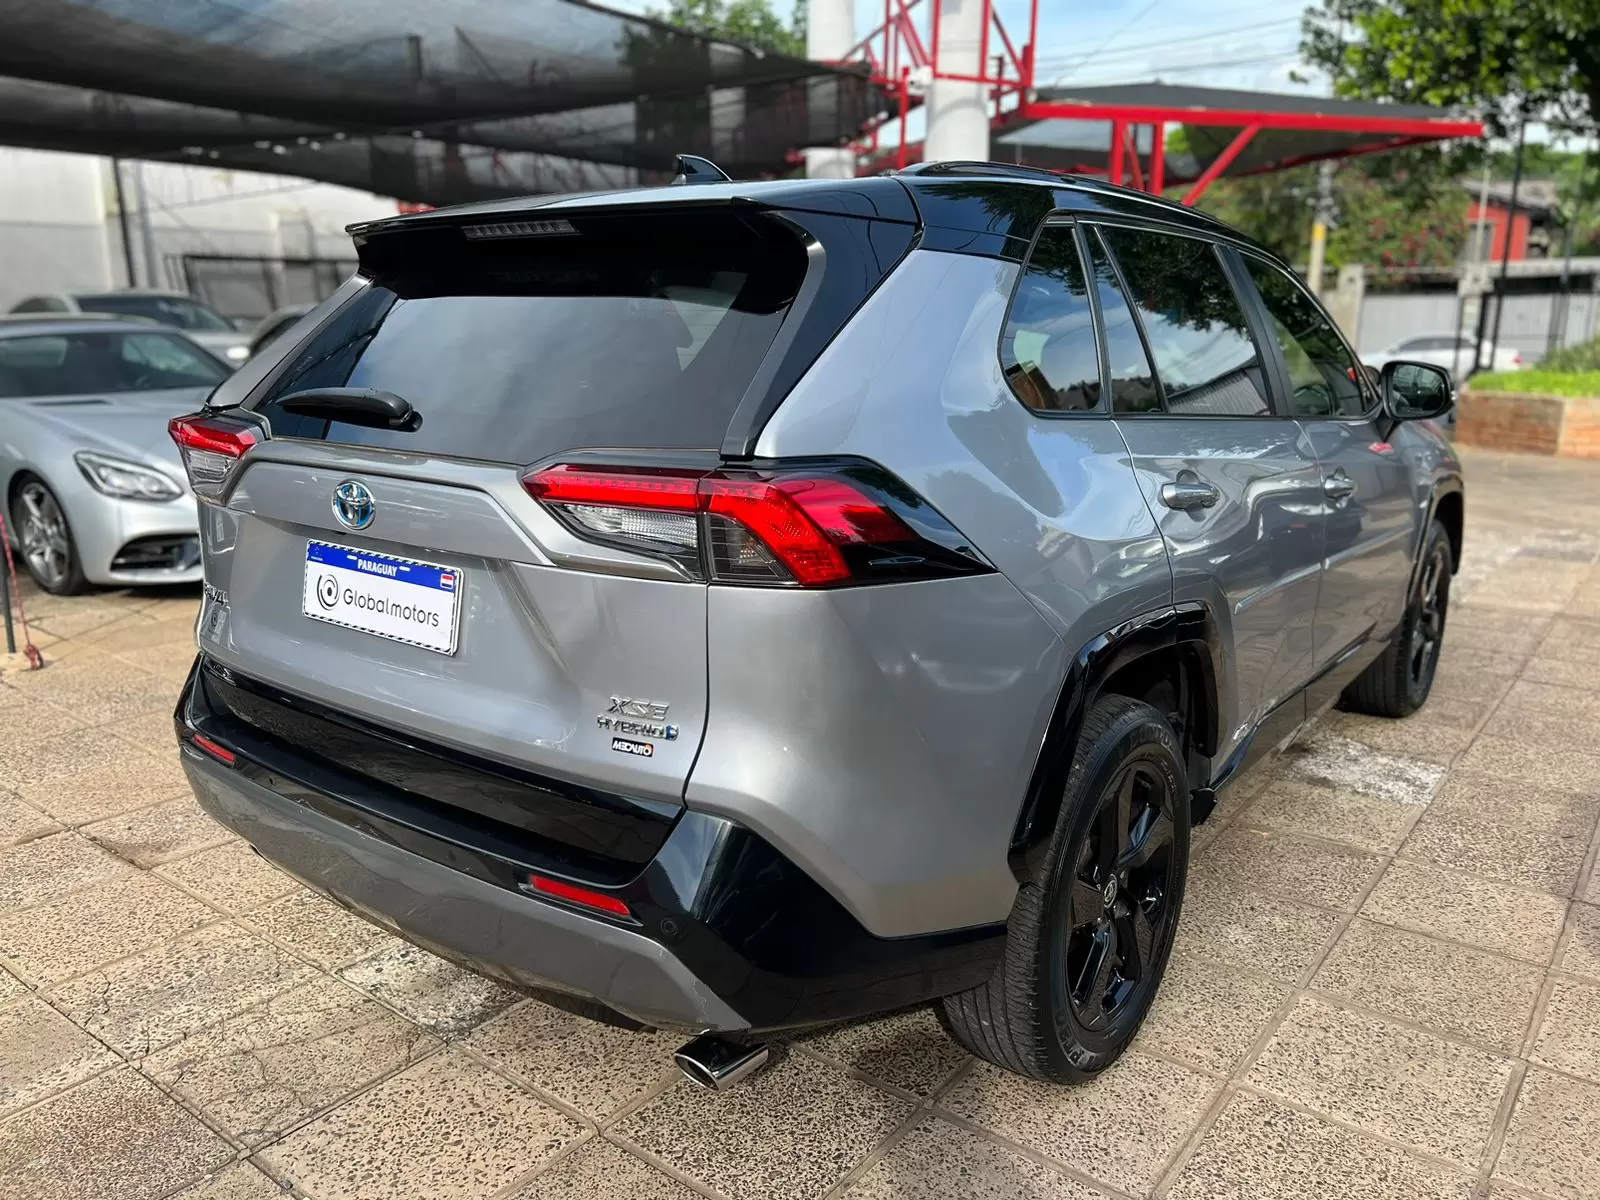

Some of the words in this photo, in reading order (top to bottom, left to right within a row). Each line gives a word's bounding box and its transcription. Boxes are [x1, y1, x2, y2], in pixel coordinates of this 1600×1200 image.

[357, 559, 398, 577] PARAGUAY
[343, 588, 440, 628] Globalmotors
[606, 695, 669, 721] XSE
[597, 714, 665, 739] HYBRID
[612, 740, 652, 757] MECAUTO
